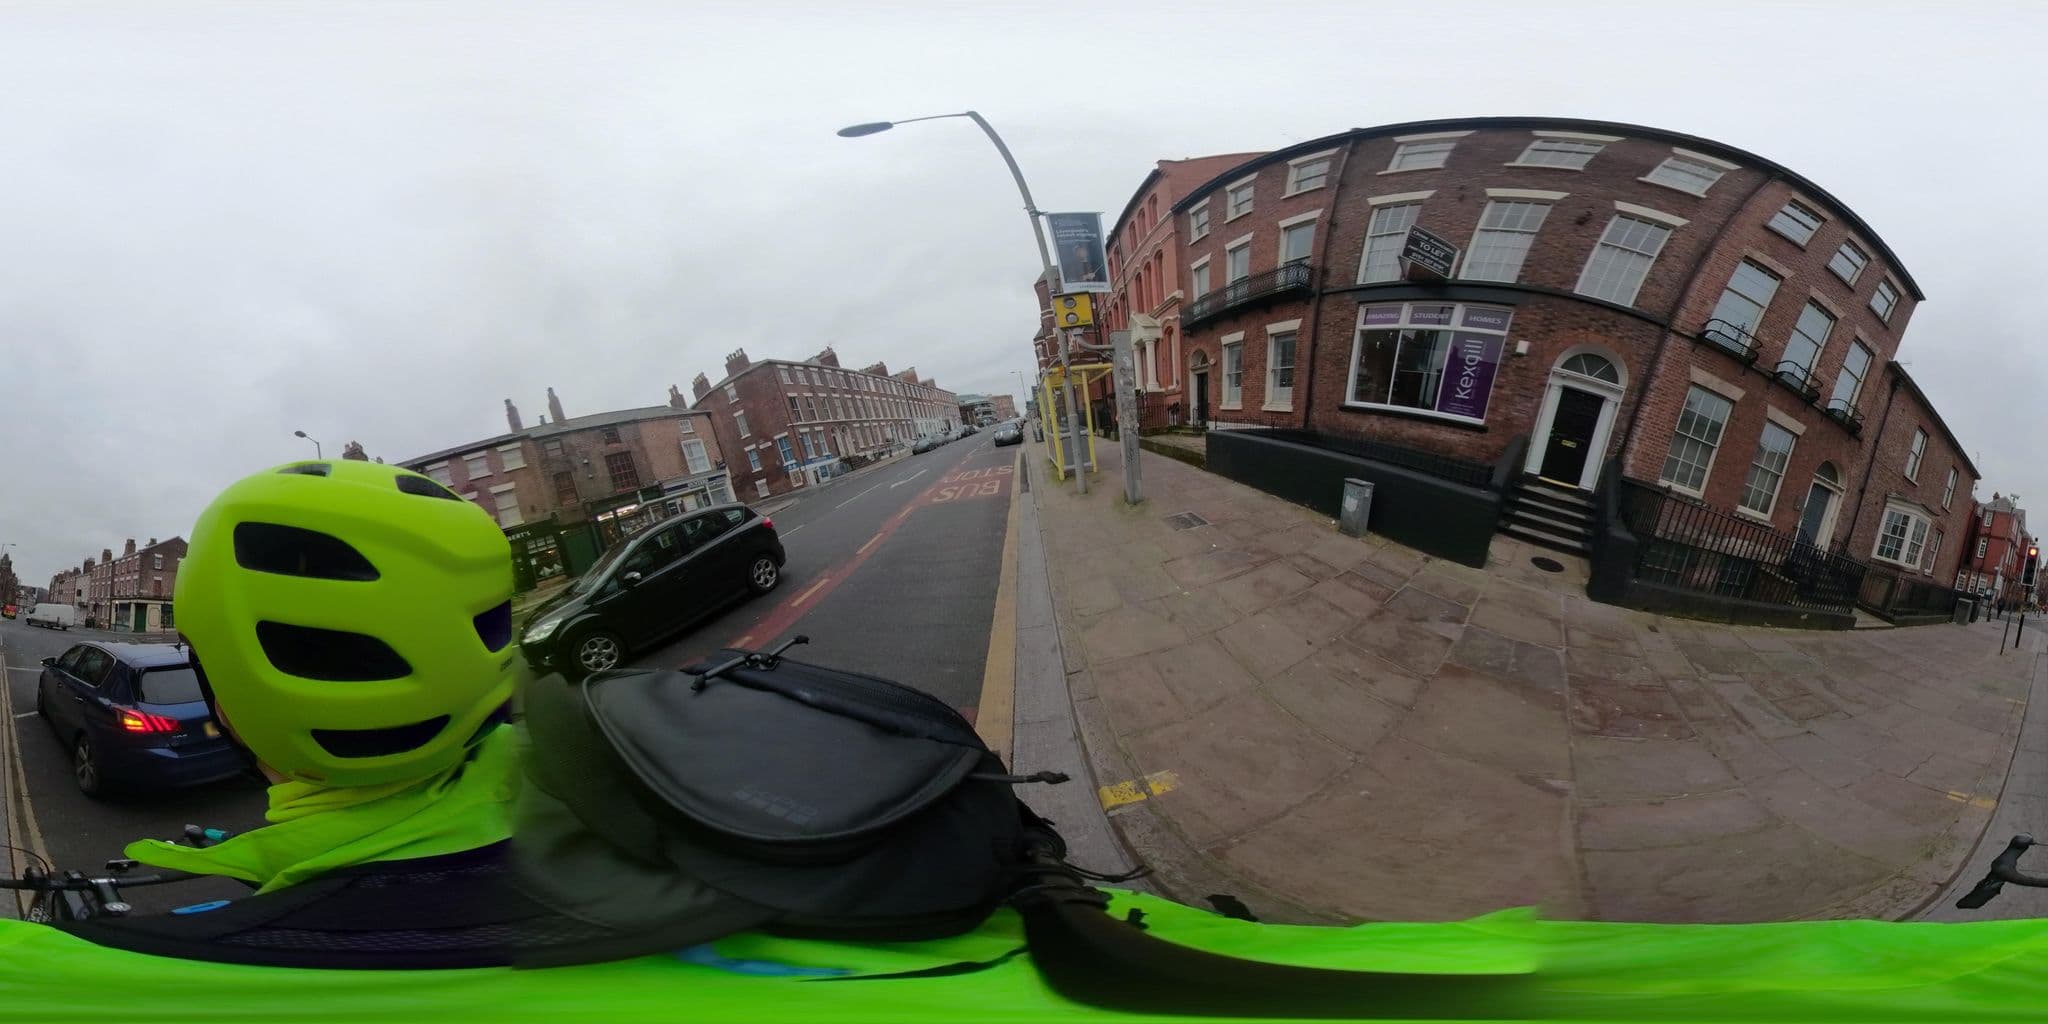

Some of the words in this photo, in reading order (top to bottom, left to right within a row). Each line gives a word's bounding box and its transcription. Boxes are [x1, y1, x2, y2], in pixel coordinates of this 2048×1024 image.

[1420, 240, 1431, 251] TO
[1431, 247, 1445, 258] LET
[1366, 312, 1400, 320] AMAZING
[1413, 312, 1449, 320] STUDENT
[1469, 315, 1502, 324] HOMES
[1454, 339, 1484, 400] Kexgill
[933, 480, 1000, 502] BUS
